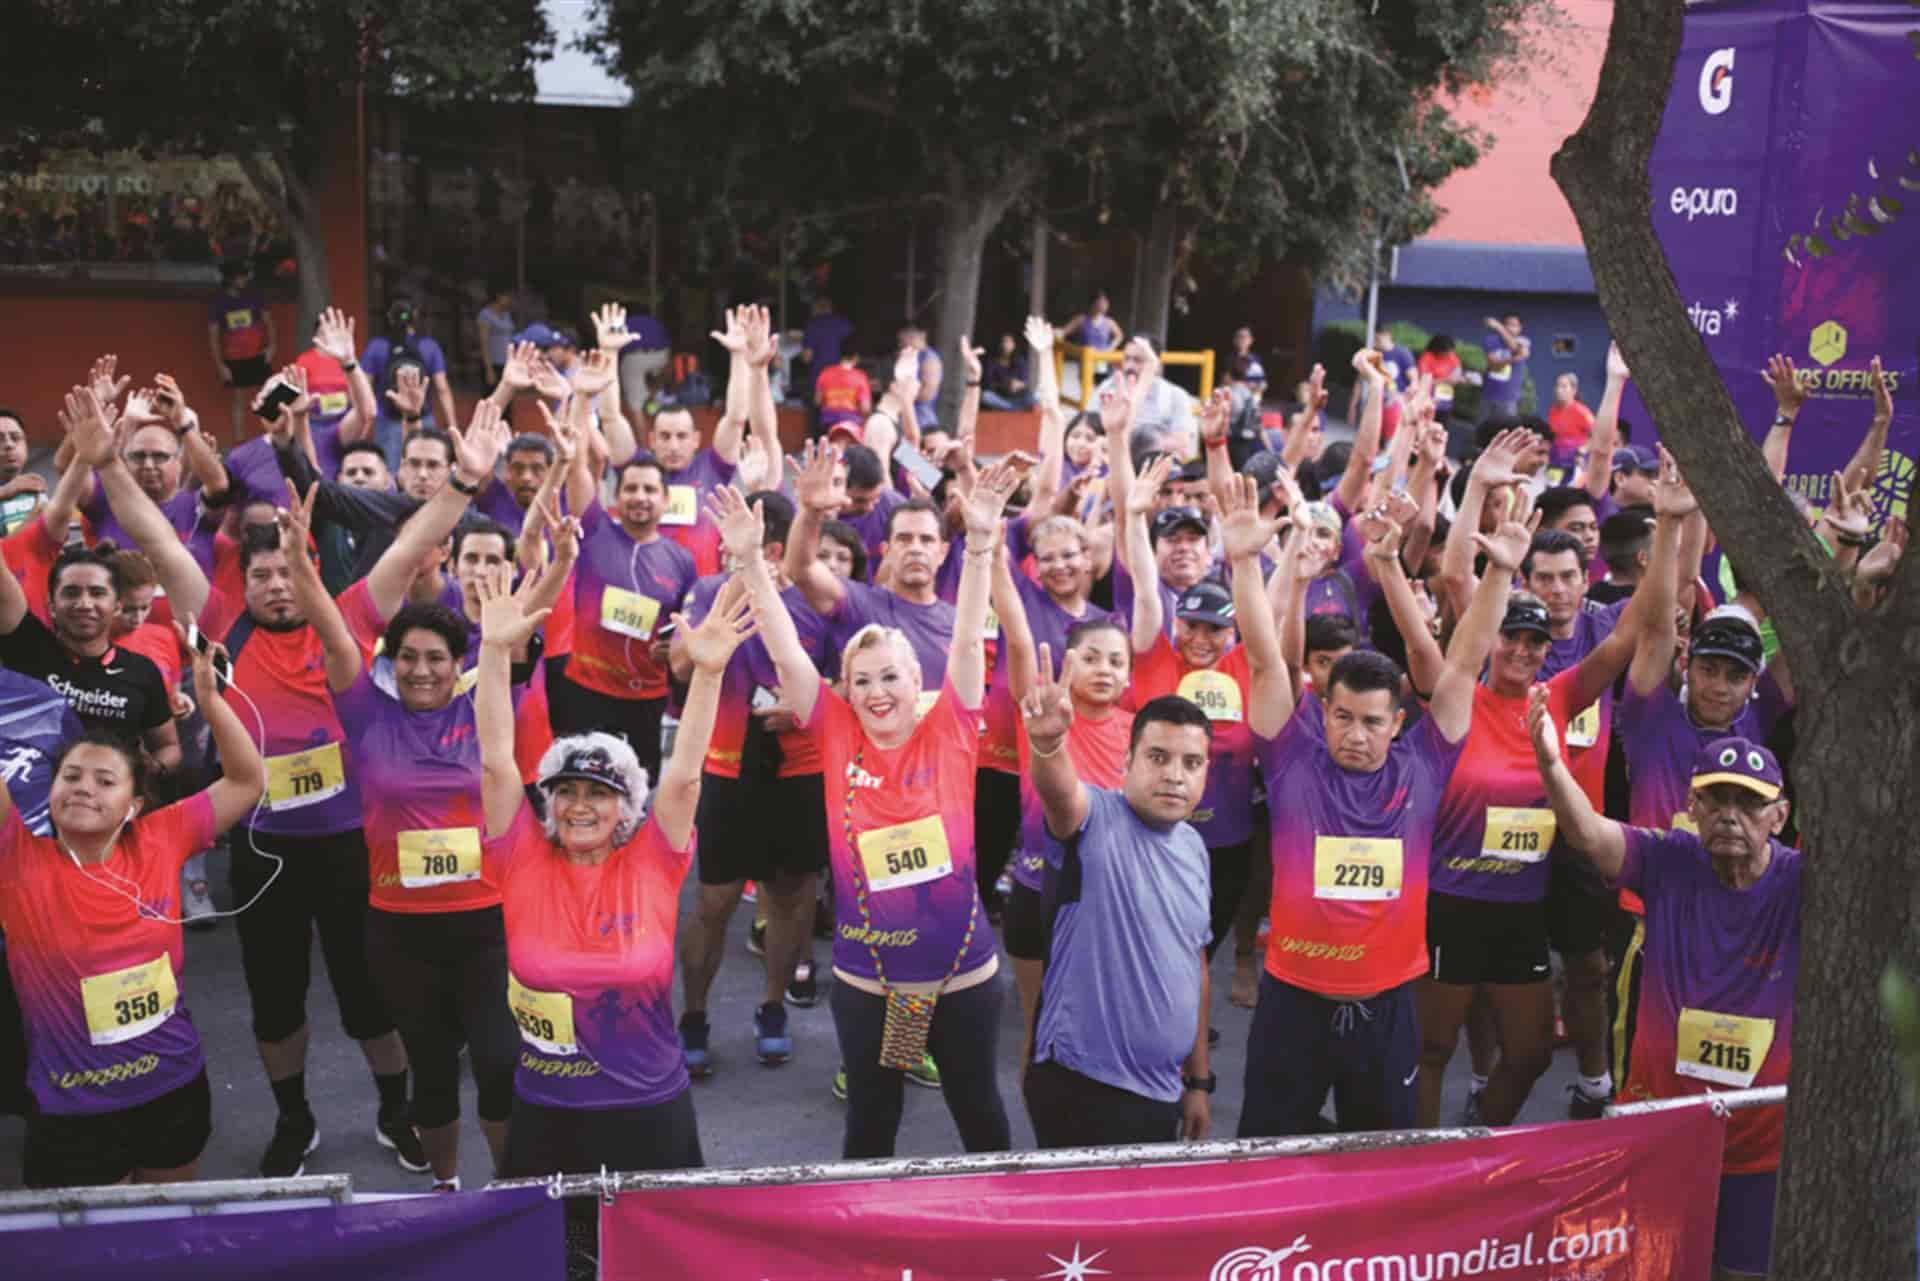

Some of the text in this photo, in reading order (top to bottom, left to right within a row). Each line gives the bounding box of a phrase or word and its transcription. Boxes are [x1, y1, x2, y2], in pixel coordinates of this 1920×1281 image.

[47, 673, 128, 708] Schneider
[1194, 691, 1227, 709] 505
[290, 772, 323, 797] 779
[1501, 831, 1539, 851] 2113
[422, 854, 459, 876] 780
[885, 846, 928, 875] 540
[1334, 864, 1384, 888] 2279
[114, 991, 160, 1026] 358
[1699, 1039, 1751, 1072] 2115
[1292, 1227, 1629, 1281] occmundial.com
